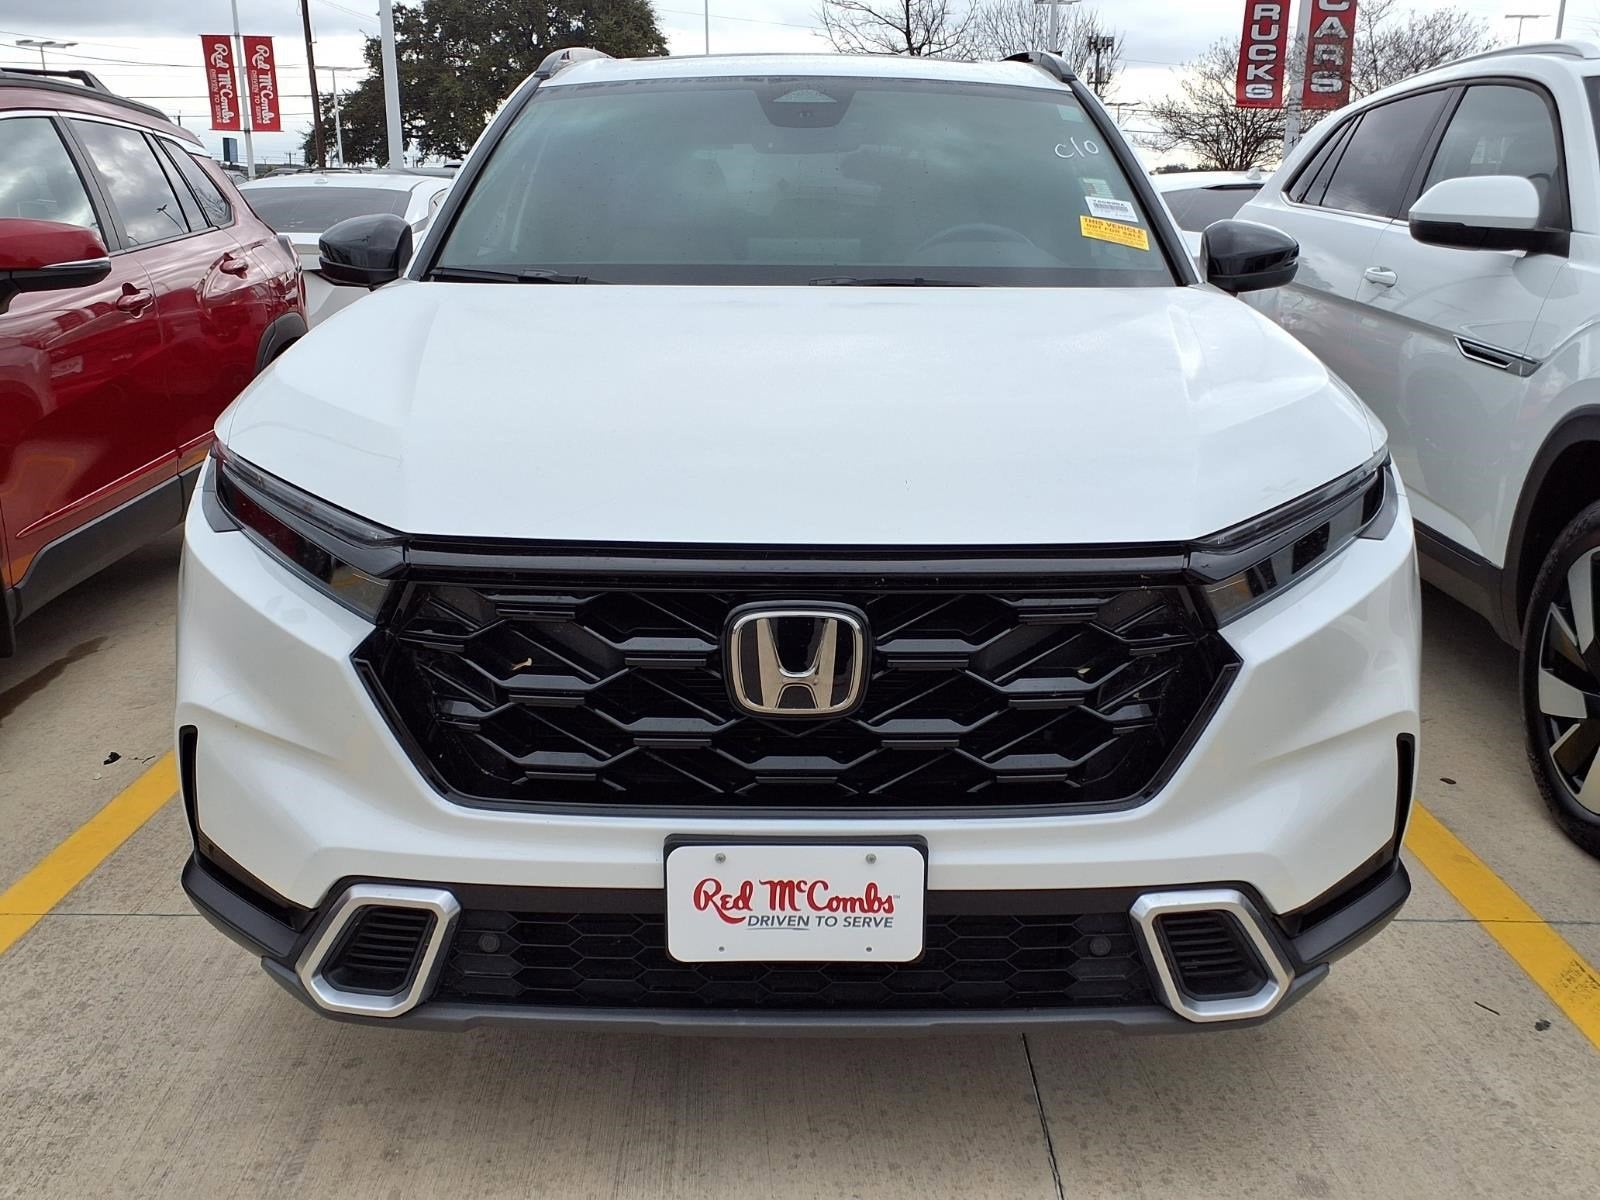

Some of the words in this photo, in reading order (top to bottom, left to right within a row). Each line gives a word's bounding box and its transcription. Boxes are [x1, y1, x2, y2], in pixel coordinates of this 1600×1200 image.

[211, 43, 230, 68] Red
[252, 45, 270, 69] Red
[1245, 4, 1281, 99] RUCKS
[1084, 217, 1103, 226] THIS
[1106, 223, 1144, 235] VEHICLE
[693, 878, 754, 925] Red
[759, 879, 895, 914] McCombs
[747, 915, 810, 928] DRIVEN
[816, 916, 838, 928] TO
[842, 916, 894, 929] SERVE
